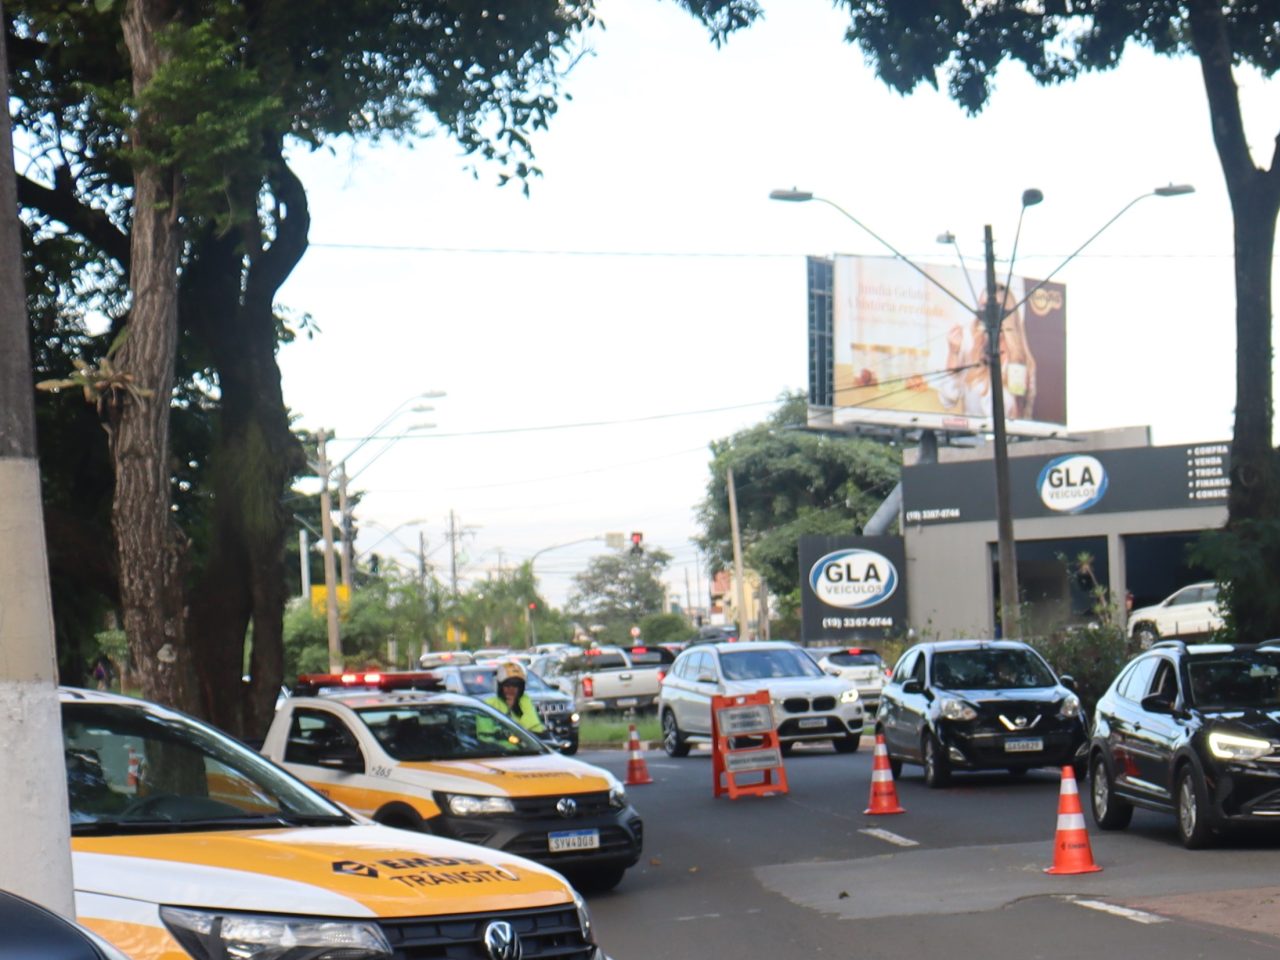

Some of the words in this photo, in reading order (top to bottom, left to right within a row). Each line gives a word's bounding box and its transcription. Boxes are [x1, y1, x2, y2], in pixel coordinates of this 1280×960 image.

[1194, 445, 1228, 456] COMPRA
[1194, 456, 1222, 467] VENDA
[1048, 465, 1095, 488] GLA
[1195, 467, 1223, 477] TROCA
[825, 562, 881, 582] GLA
